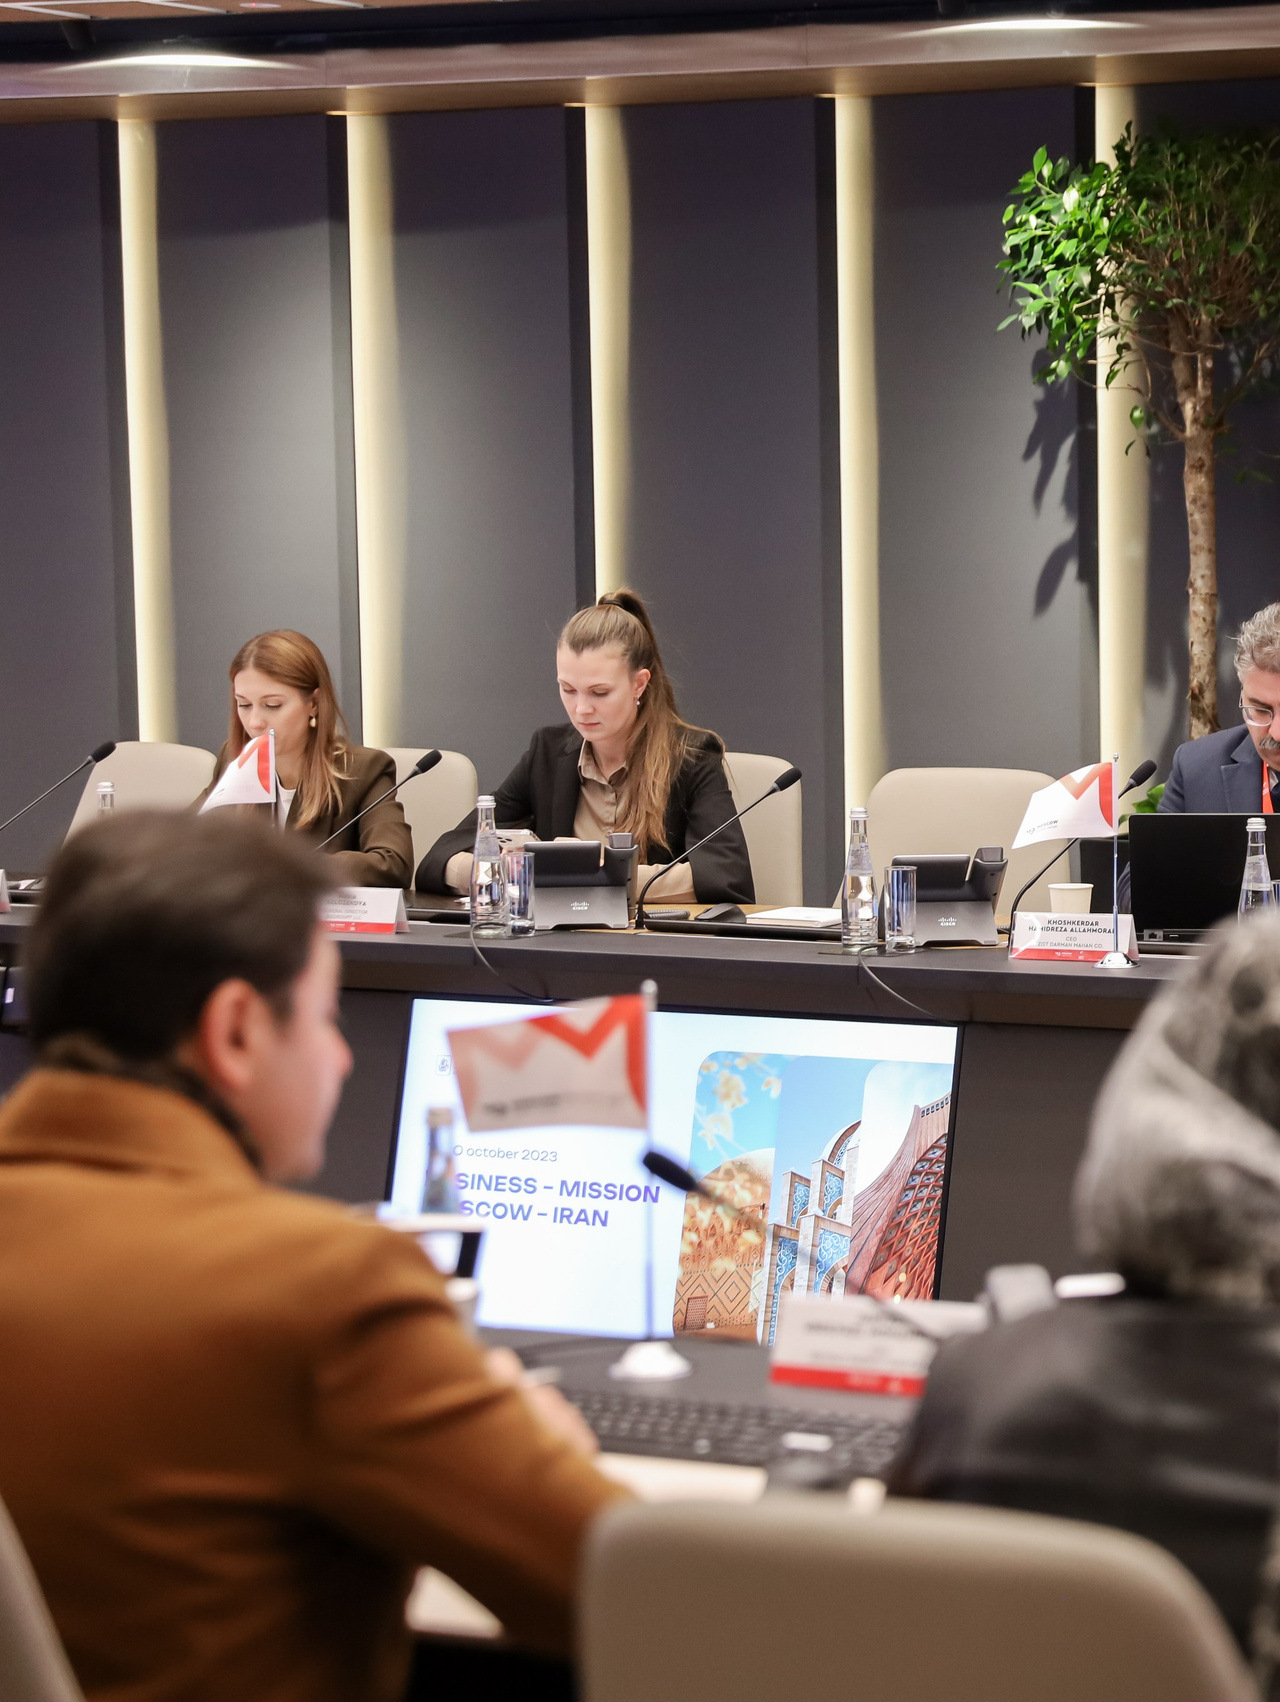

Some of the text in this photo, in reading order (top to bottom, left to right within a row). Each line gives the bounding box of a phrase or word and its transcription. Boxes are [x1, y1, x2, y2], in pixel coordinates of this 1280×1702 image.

[466, 1146, 519, 1160] october
[522, 1149, 558, 1162] 2023
[456, 1172, 538, 1194] SINESS
[559, 1180, 660, 1204] MISSION
[460, 1200, 533, 1221] SCOW
[552, 1206, 608, 1227] IRAN
